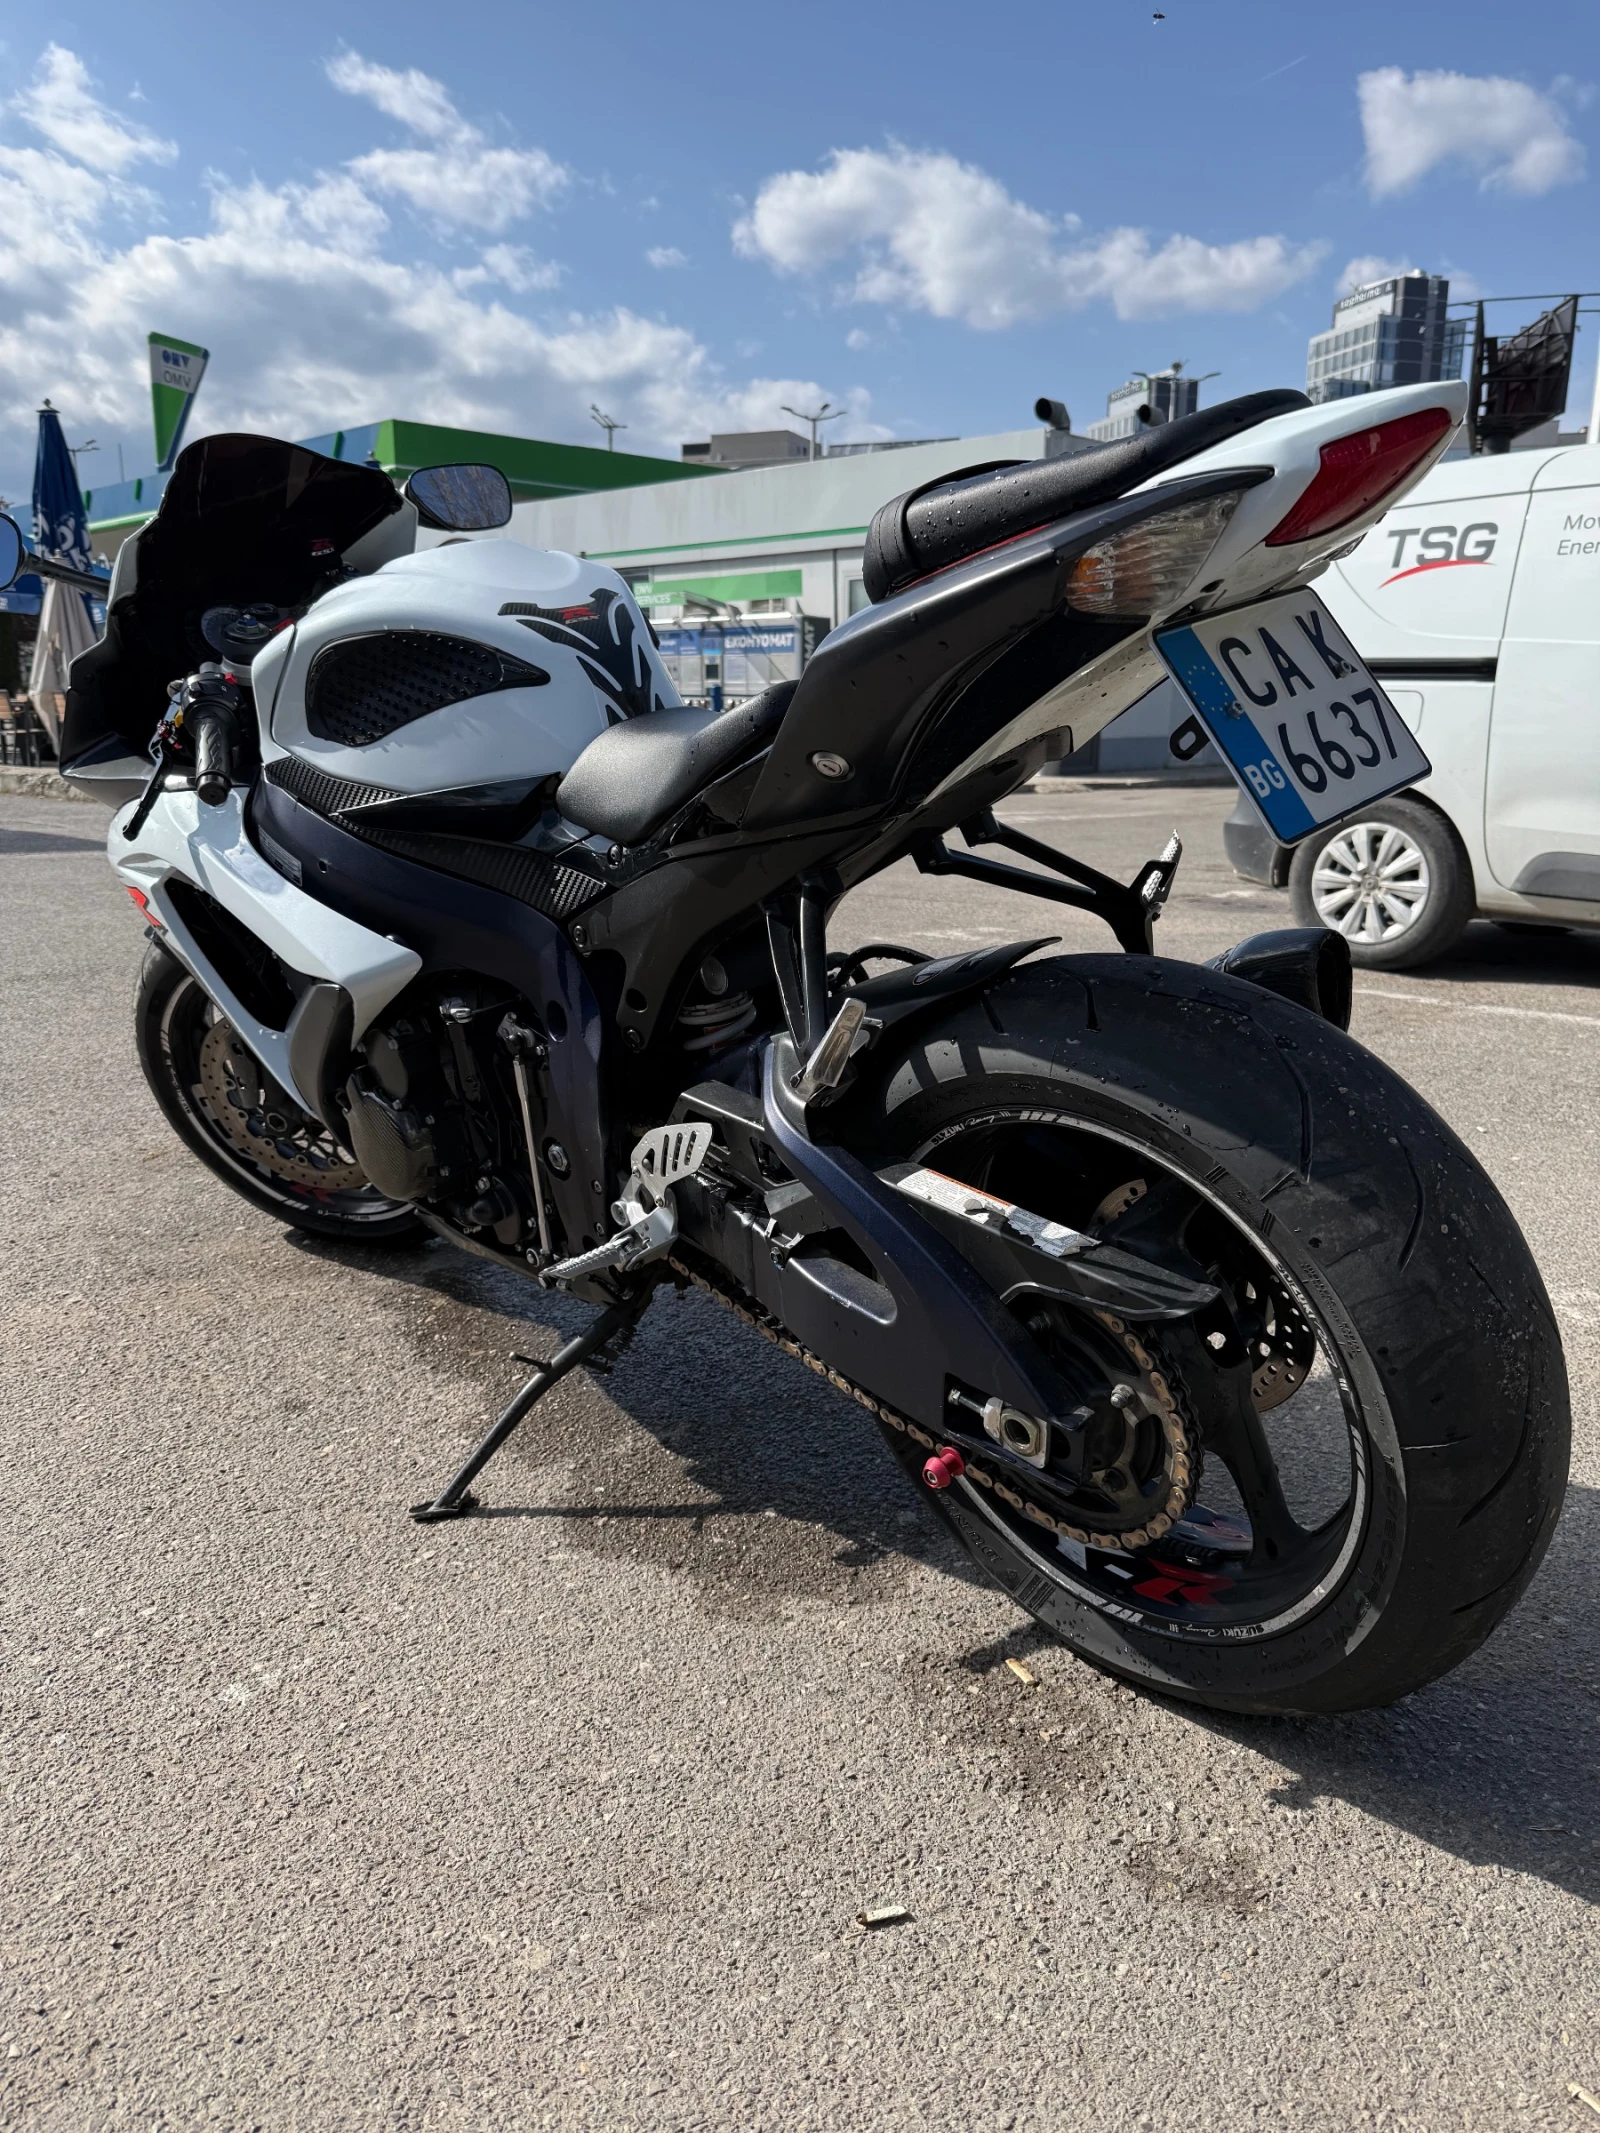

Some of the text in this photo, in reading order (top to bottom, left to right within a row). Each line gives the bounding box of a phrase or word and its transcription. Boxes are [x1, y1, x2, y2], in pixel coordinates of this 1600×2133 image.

[162, 349, 190, 369] OMV
[164, 370, 192, 389] OMV
[1563, 513, 1600, 531] Mo
[1387, 522, 1498, 569] TSG
[1557, 539, 1600, 556] Ener
[1294, 610, 1359, 680] K
[1277, 687, 1398, 794] 6637
[1243, 758, 1286, 799] BG
[1221, 1624, 1265, 1639] SUZUKI
